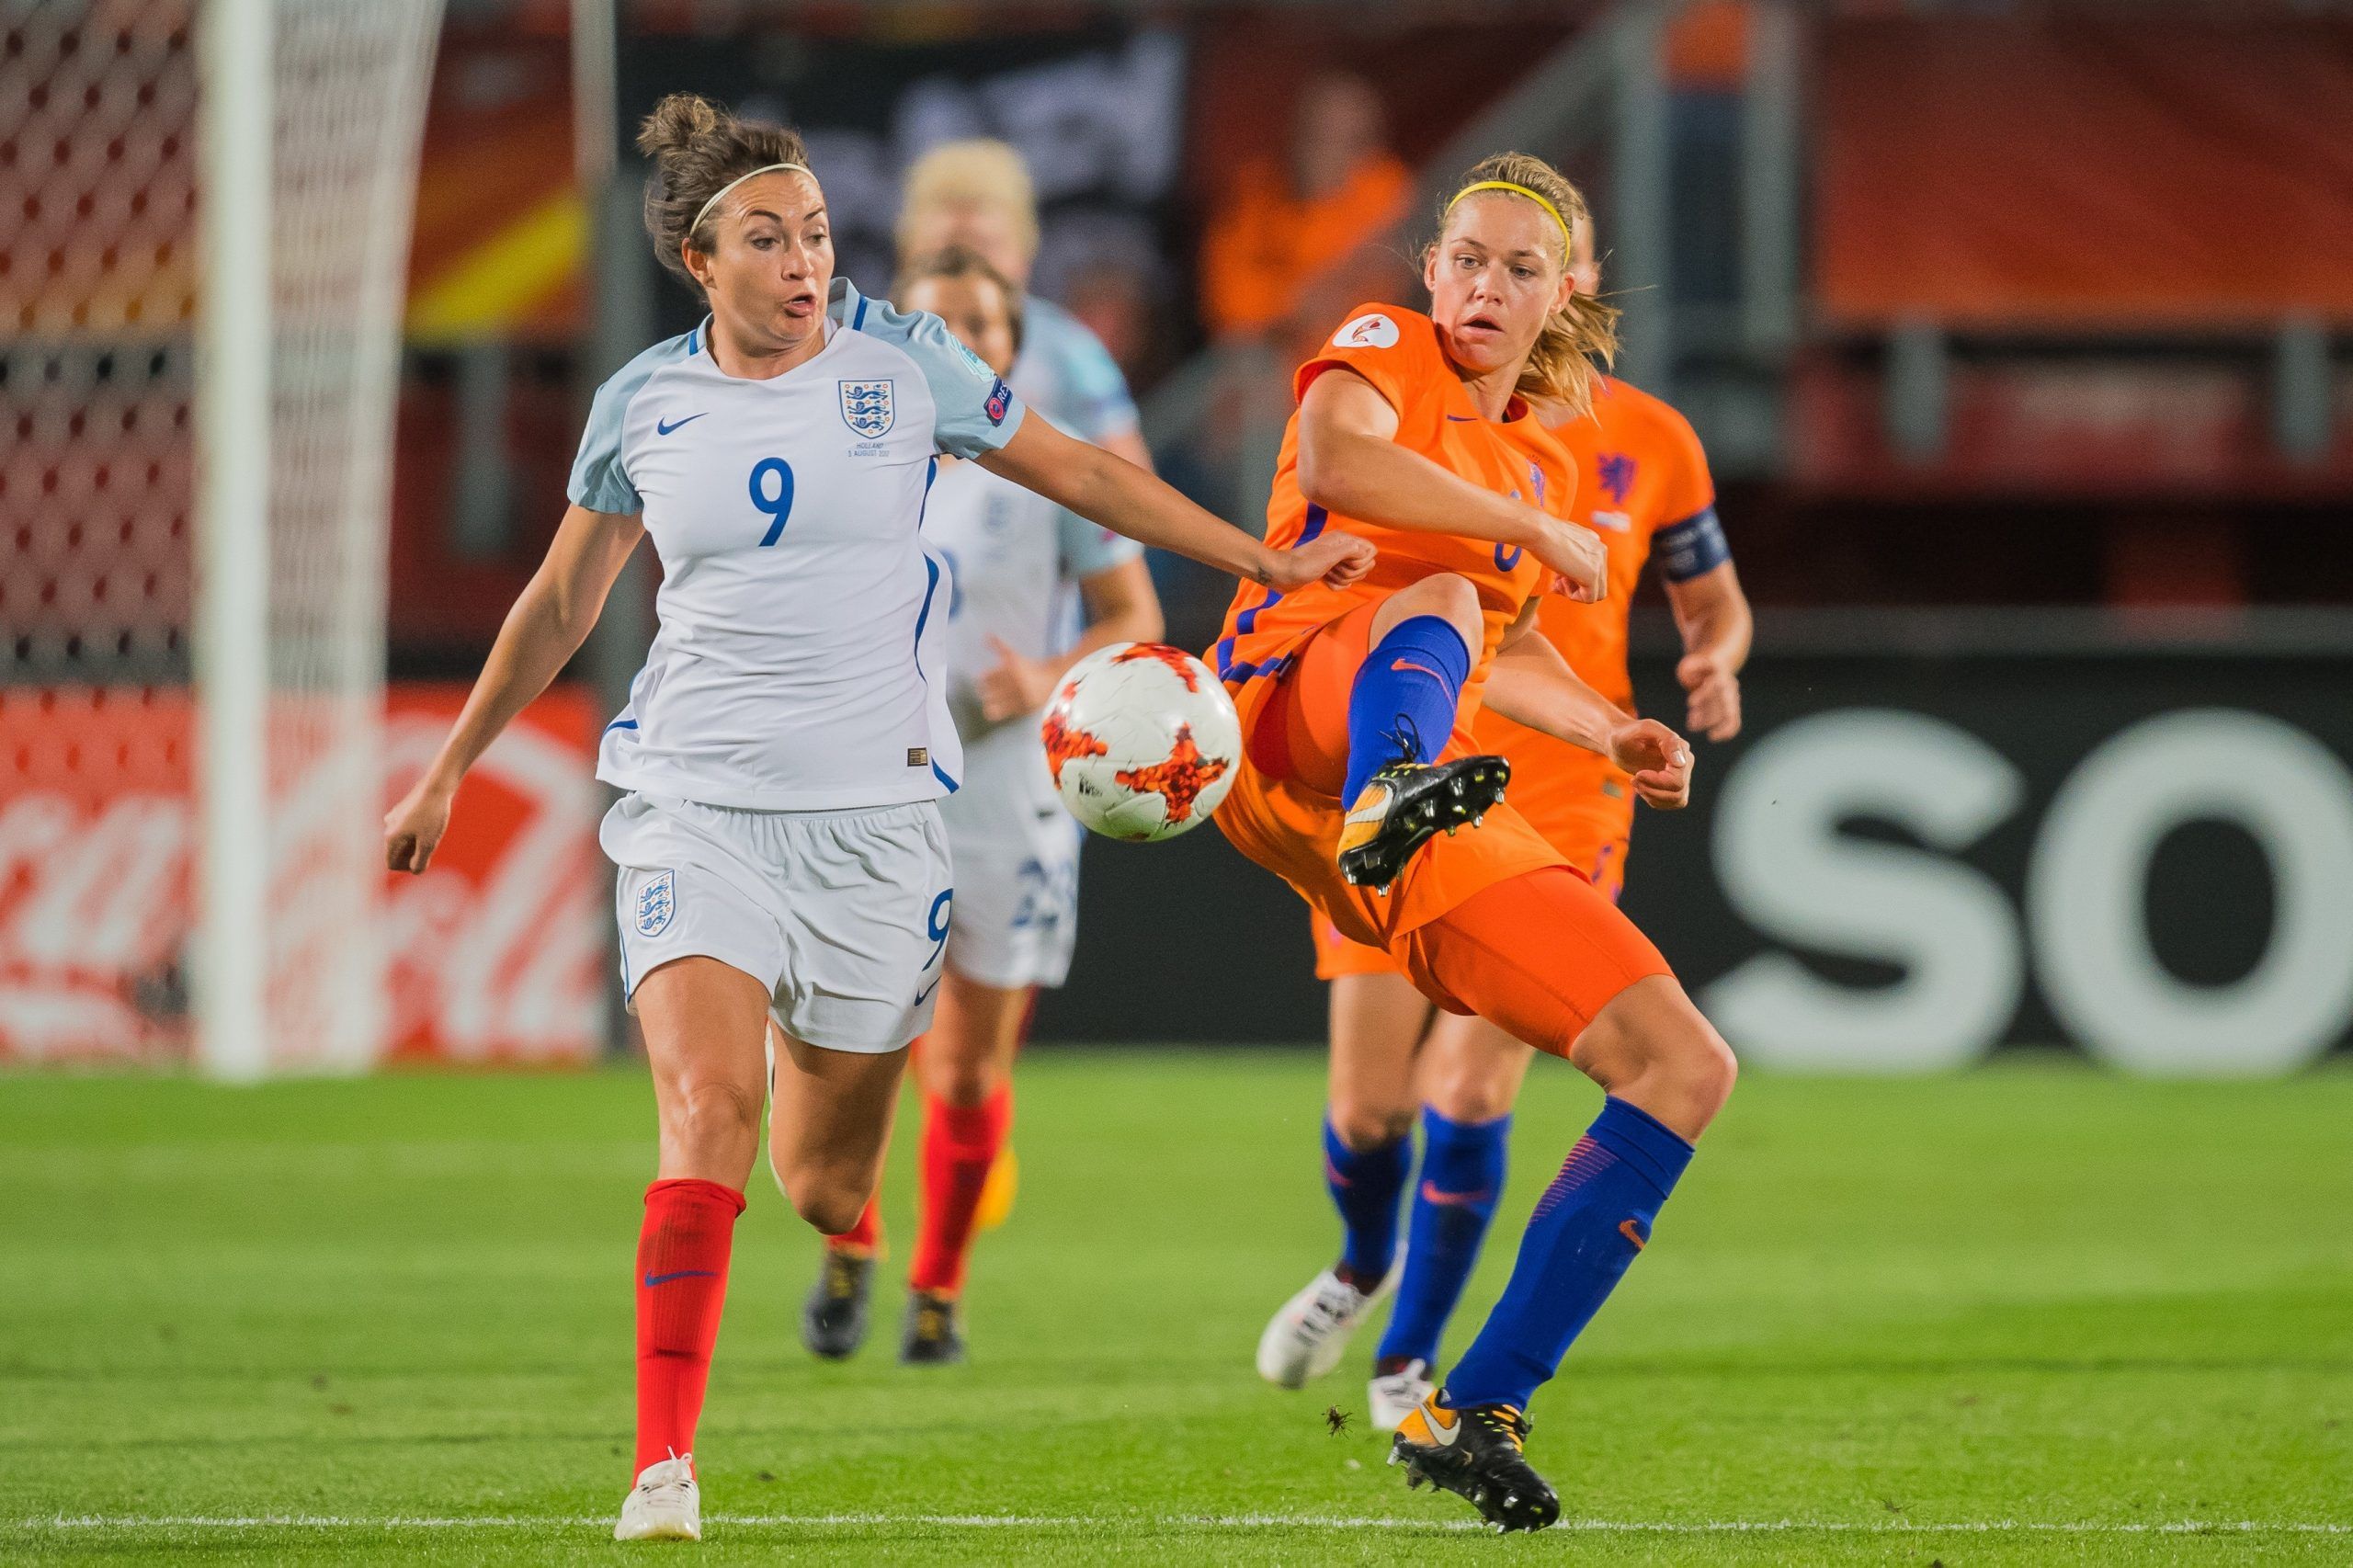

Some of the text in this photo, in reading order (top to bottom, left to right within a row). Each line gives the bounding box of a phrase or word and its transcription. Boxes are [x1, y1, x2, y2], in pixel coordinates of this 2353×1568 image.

[748, 457, 795, 547] 9
[922, 887, 954, 971] 9
[1705, 707, 2353, 1075] SO
